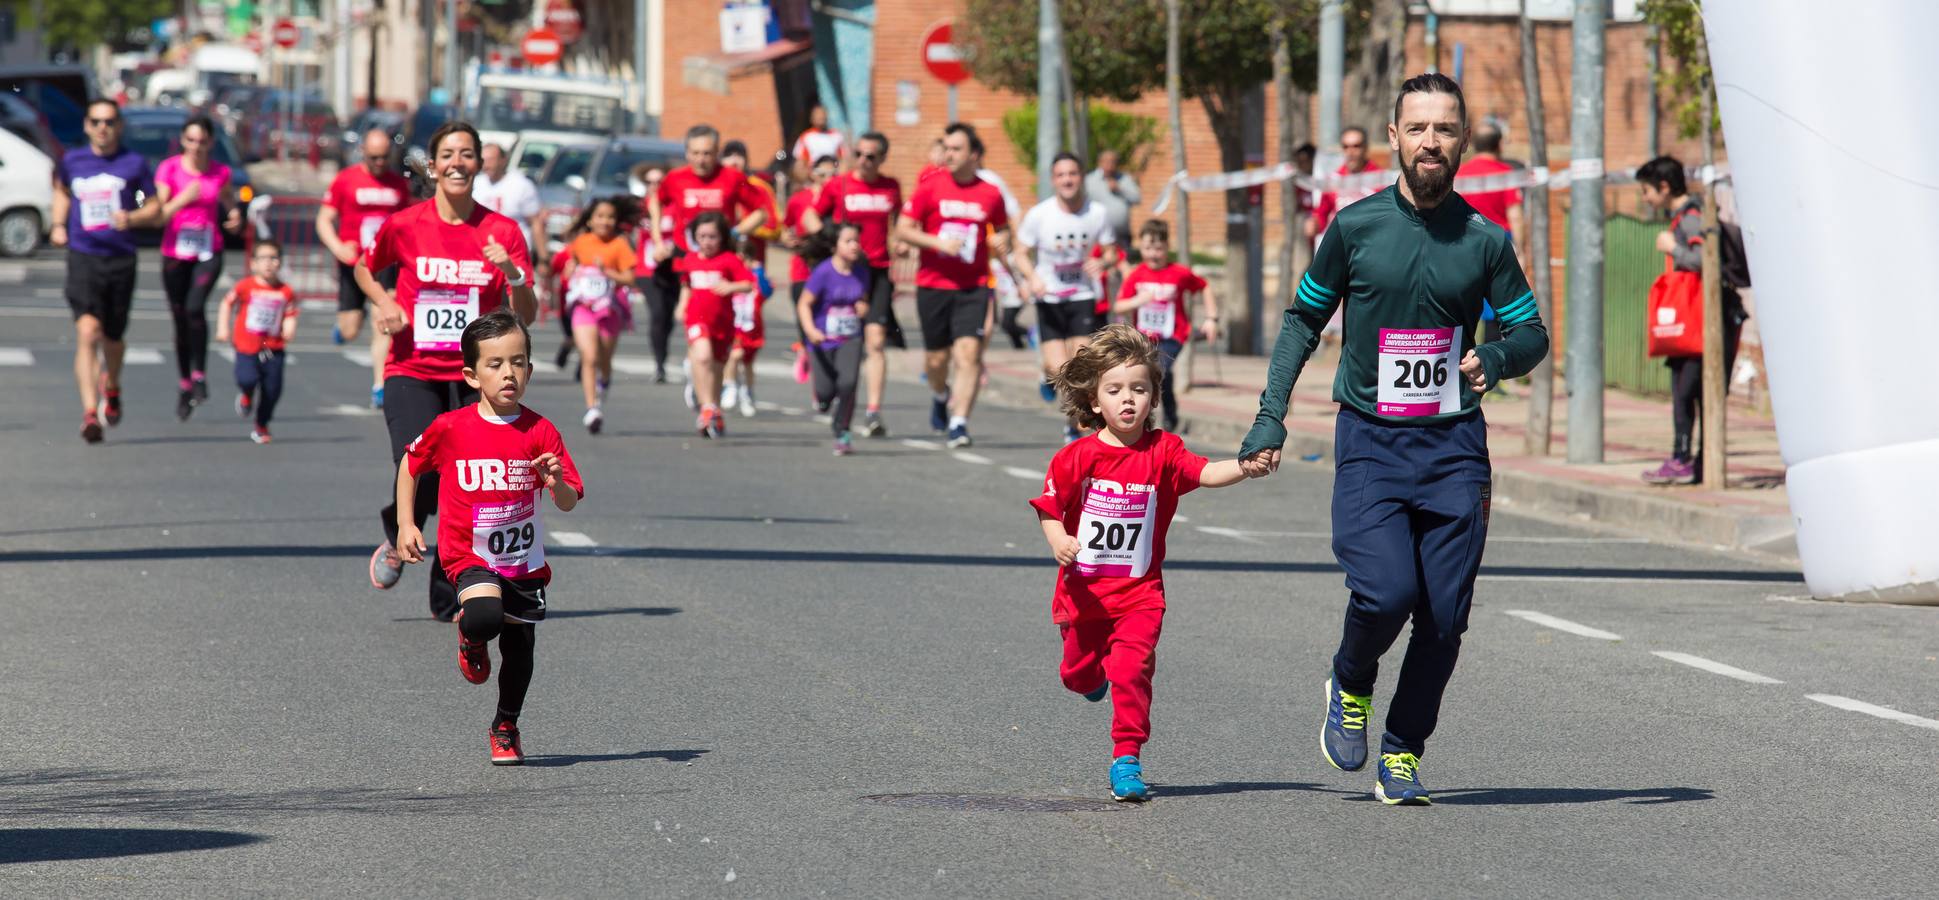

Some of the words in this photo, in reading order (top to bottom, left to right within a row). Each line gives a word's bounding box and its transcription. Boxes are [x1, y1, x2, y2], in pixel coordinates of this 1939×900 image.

[416, 256, 459, 284] UR
[427, 309, 467, 329] 028
[1437, 338, 1450, 346] RIOJA
[1394, 358, 1447, 388] 206
[456, 458, 508, 491] UR
[508, 483, 517, 491] DE
[517, 483, 523, 491] LA
[1126, 483, 1155, 492] CARRERA
[1086, 498, 1115, 510] UNIVERSIDAD
[1088, 492, 1106, 502] CARRERA
[1106, 496, 1129, 504] CAMPUS
[478, 511, 511, 519] UNIVERSIDAD
[488, 522, 534, 555] 029
[1088, 520, 1142, 551] 207
